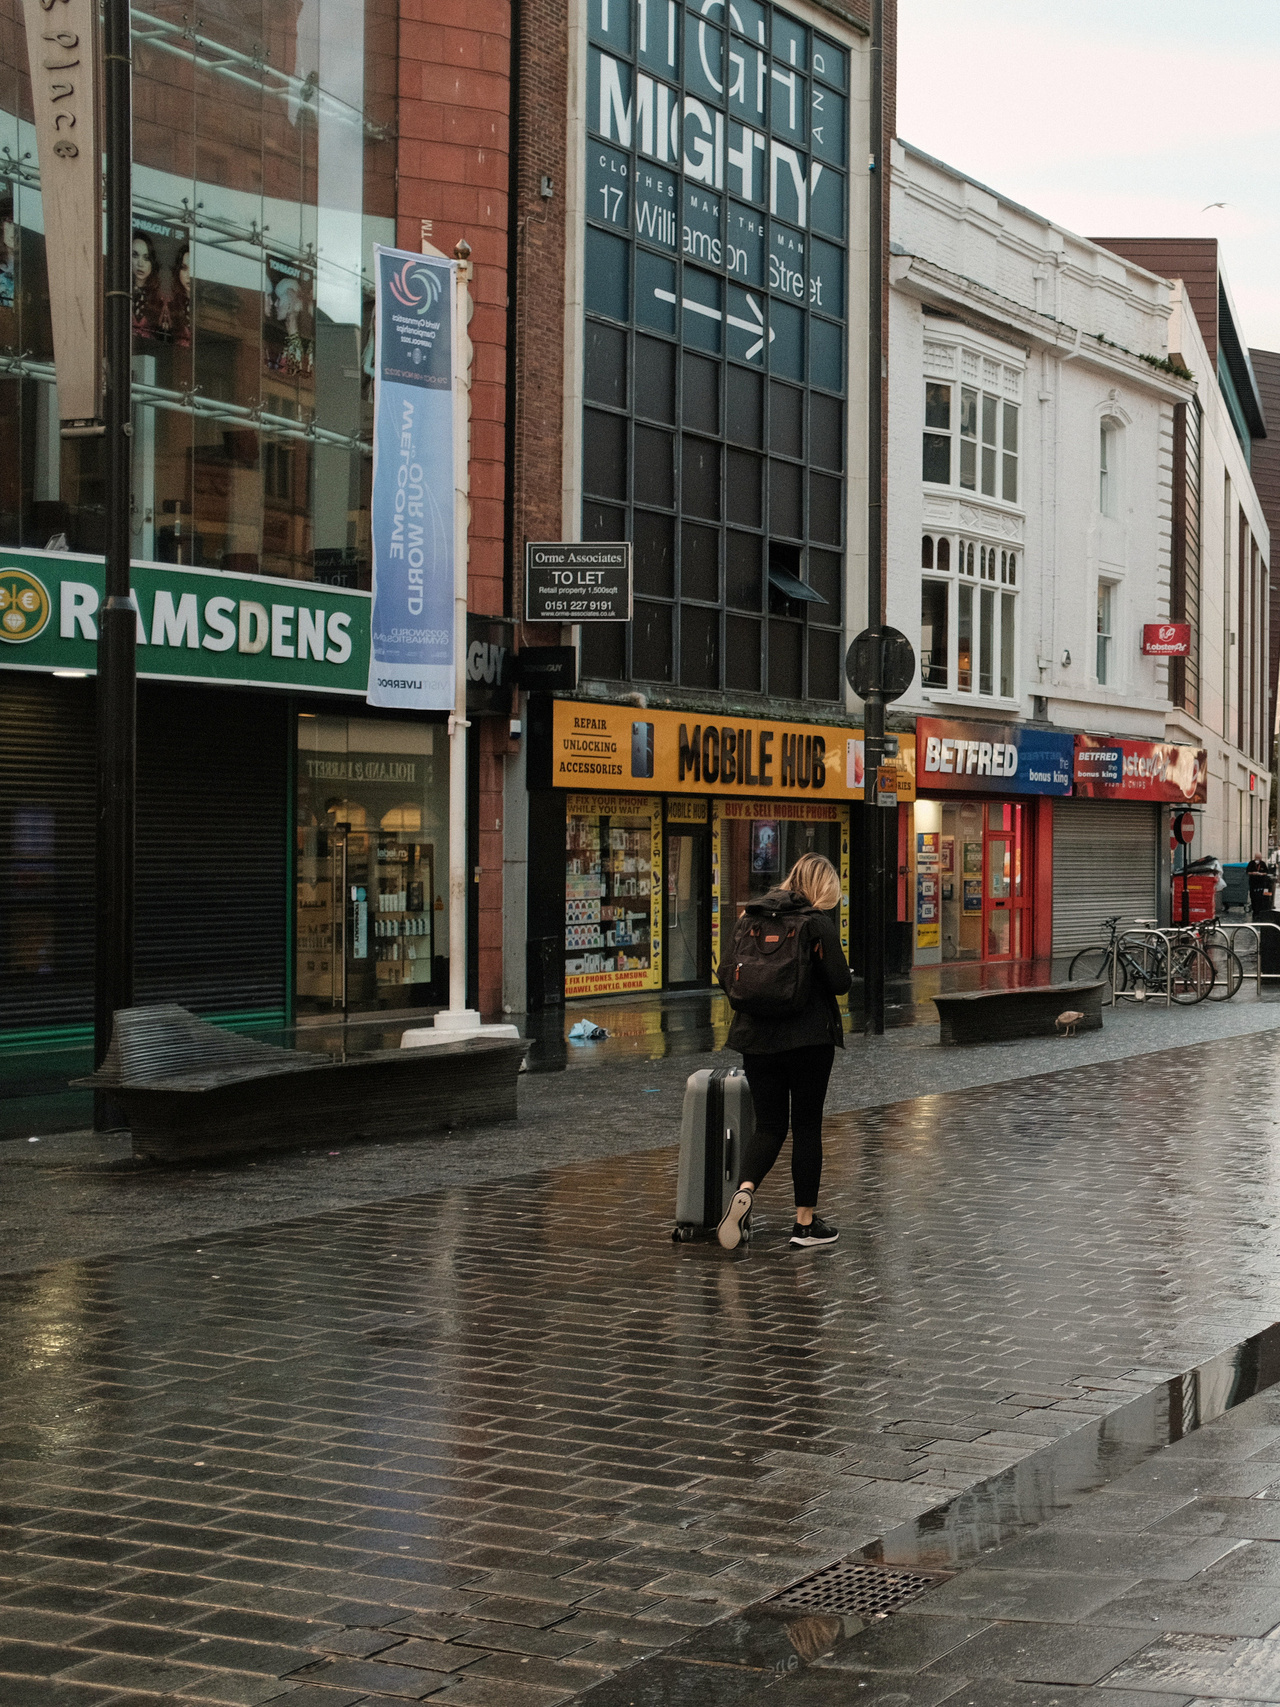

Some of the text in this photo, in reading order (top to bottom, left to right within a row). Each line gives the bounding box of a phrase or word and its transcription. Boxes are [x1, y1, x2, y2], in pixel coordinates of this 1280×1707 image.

[812, 53, 825, 144] AND
[600, 53, 823, 228] MIGHTY
[599, 155, 804, 254] CLOTHES MAKE THE MAN
[599, 184, 822, 306] 17 Williamson Street
[535, 552, 622, 563] Orme Associates
[551, 571, 605, 585] TO LET
[539, 586, 557, 594] Retail
[558, 587, 587, 595] property
[545, 601, 612, 610] 0151 227 9191
[574, 717, 607, 730] REPAIR
[563, 739, 617, 753] UNLOCKING
[678, 723, 826, 789] MOBILE HUB
[924, 736, 1018, 777] BETFRED
[1078, 752, 1118, 761] BETFRED
[559, 761, 623, 775] ACCESSORIES
[1059, 758, 1069, 770] the
[1029, 768, 1069, 786] bonus king
[1101, 771, 1118, 779] king
[575, 796, 590, 805] FIX
[592, 796, 616, 806] YOUR
[618, 797, 649, 807] PHONE
[567, 804, 640, 815] WHILE YOU WAIT
[667, 801, 706, 820] MOBILE HUB
[725, 802, 837, 820] BUY & SELL MOBILE PHONES
